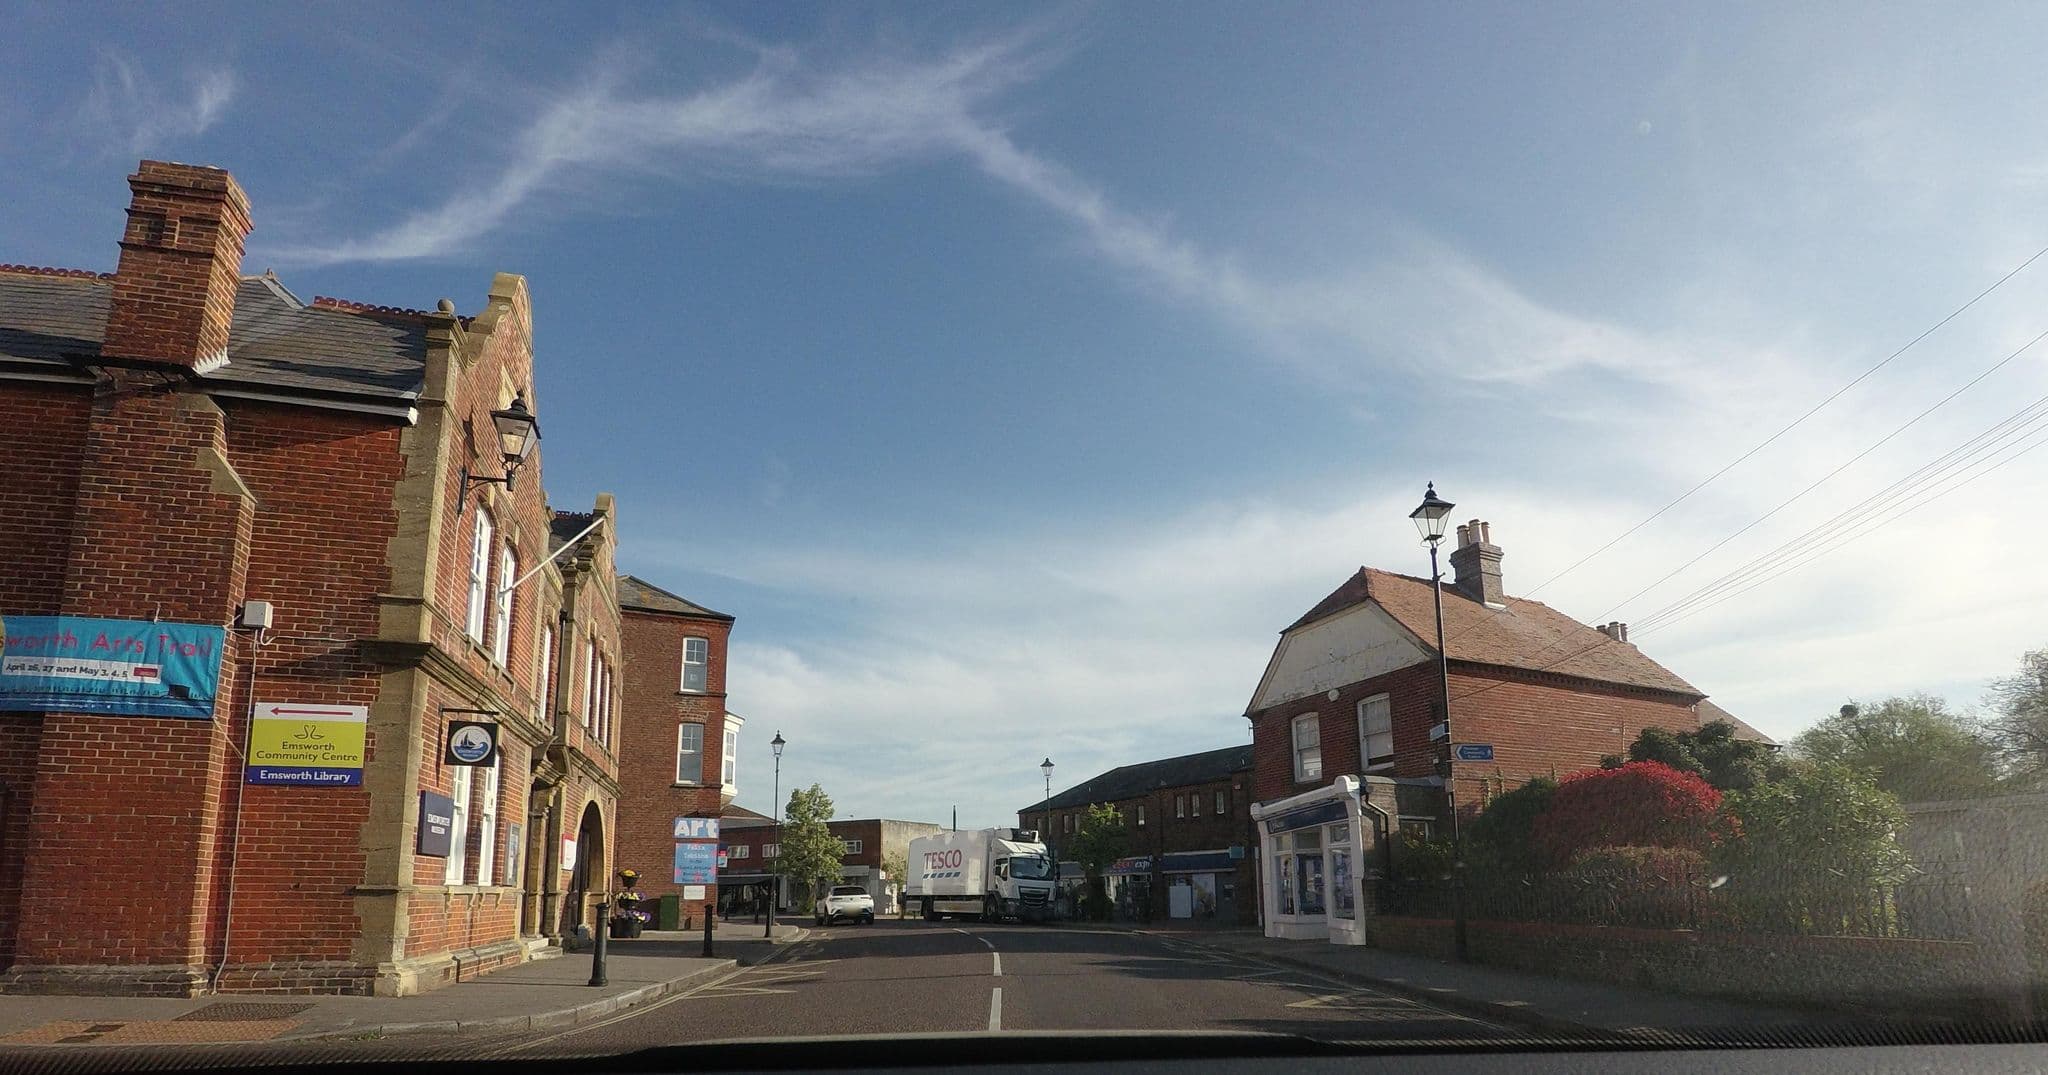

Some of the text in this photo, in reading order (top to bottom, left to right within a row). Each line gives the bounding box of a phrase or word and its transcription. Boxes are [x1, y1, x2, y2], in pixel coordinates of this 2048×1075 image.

[91, 633, 145, 653] Arts
[158, 634, 212, 657] Trail
[5, 662, 26, 673] April
[42, 665, 54, 674] 27
[56, 664, 77, 674] and
[79, 666, 99, 677] May
[282, 741, 335, 751] Emsworth
[256, 750, 358, 762] Community Centre
[260, 769, 351, 783] Emsworth Library
[674, 818, 718, 838] Art
[924, 849, 962, 870] TESCO
